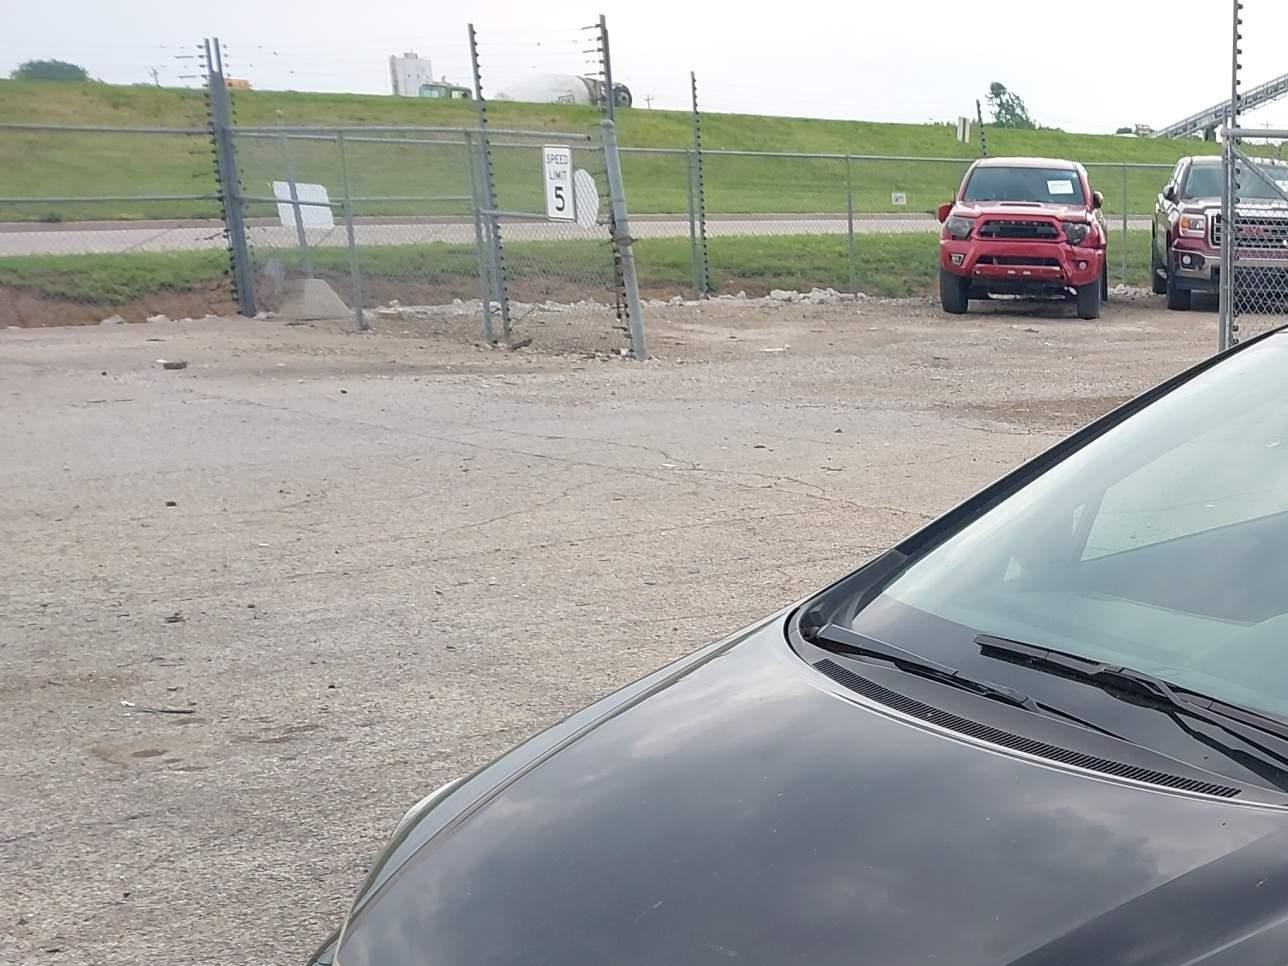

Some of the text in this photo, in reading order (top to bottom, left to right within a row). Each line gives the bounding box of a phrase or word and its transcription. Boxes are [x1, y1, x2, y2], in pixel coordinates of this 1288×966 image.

[546, 154, 569, 165] SPEED
[549, 169, 568, 180] LIMIT
[554, 186, 566, 212] 5
